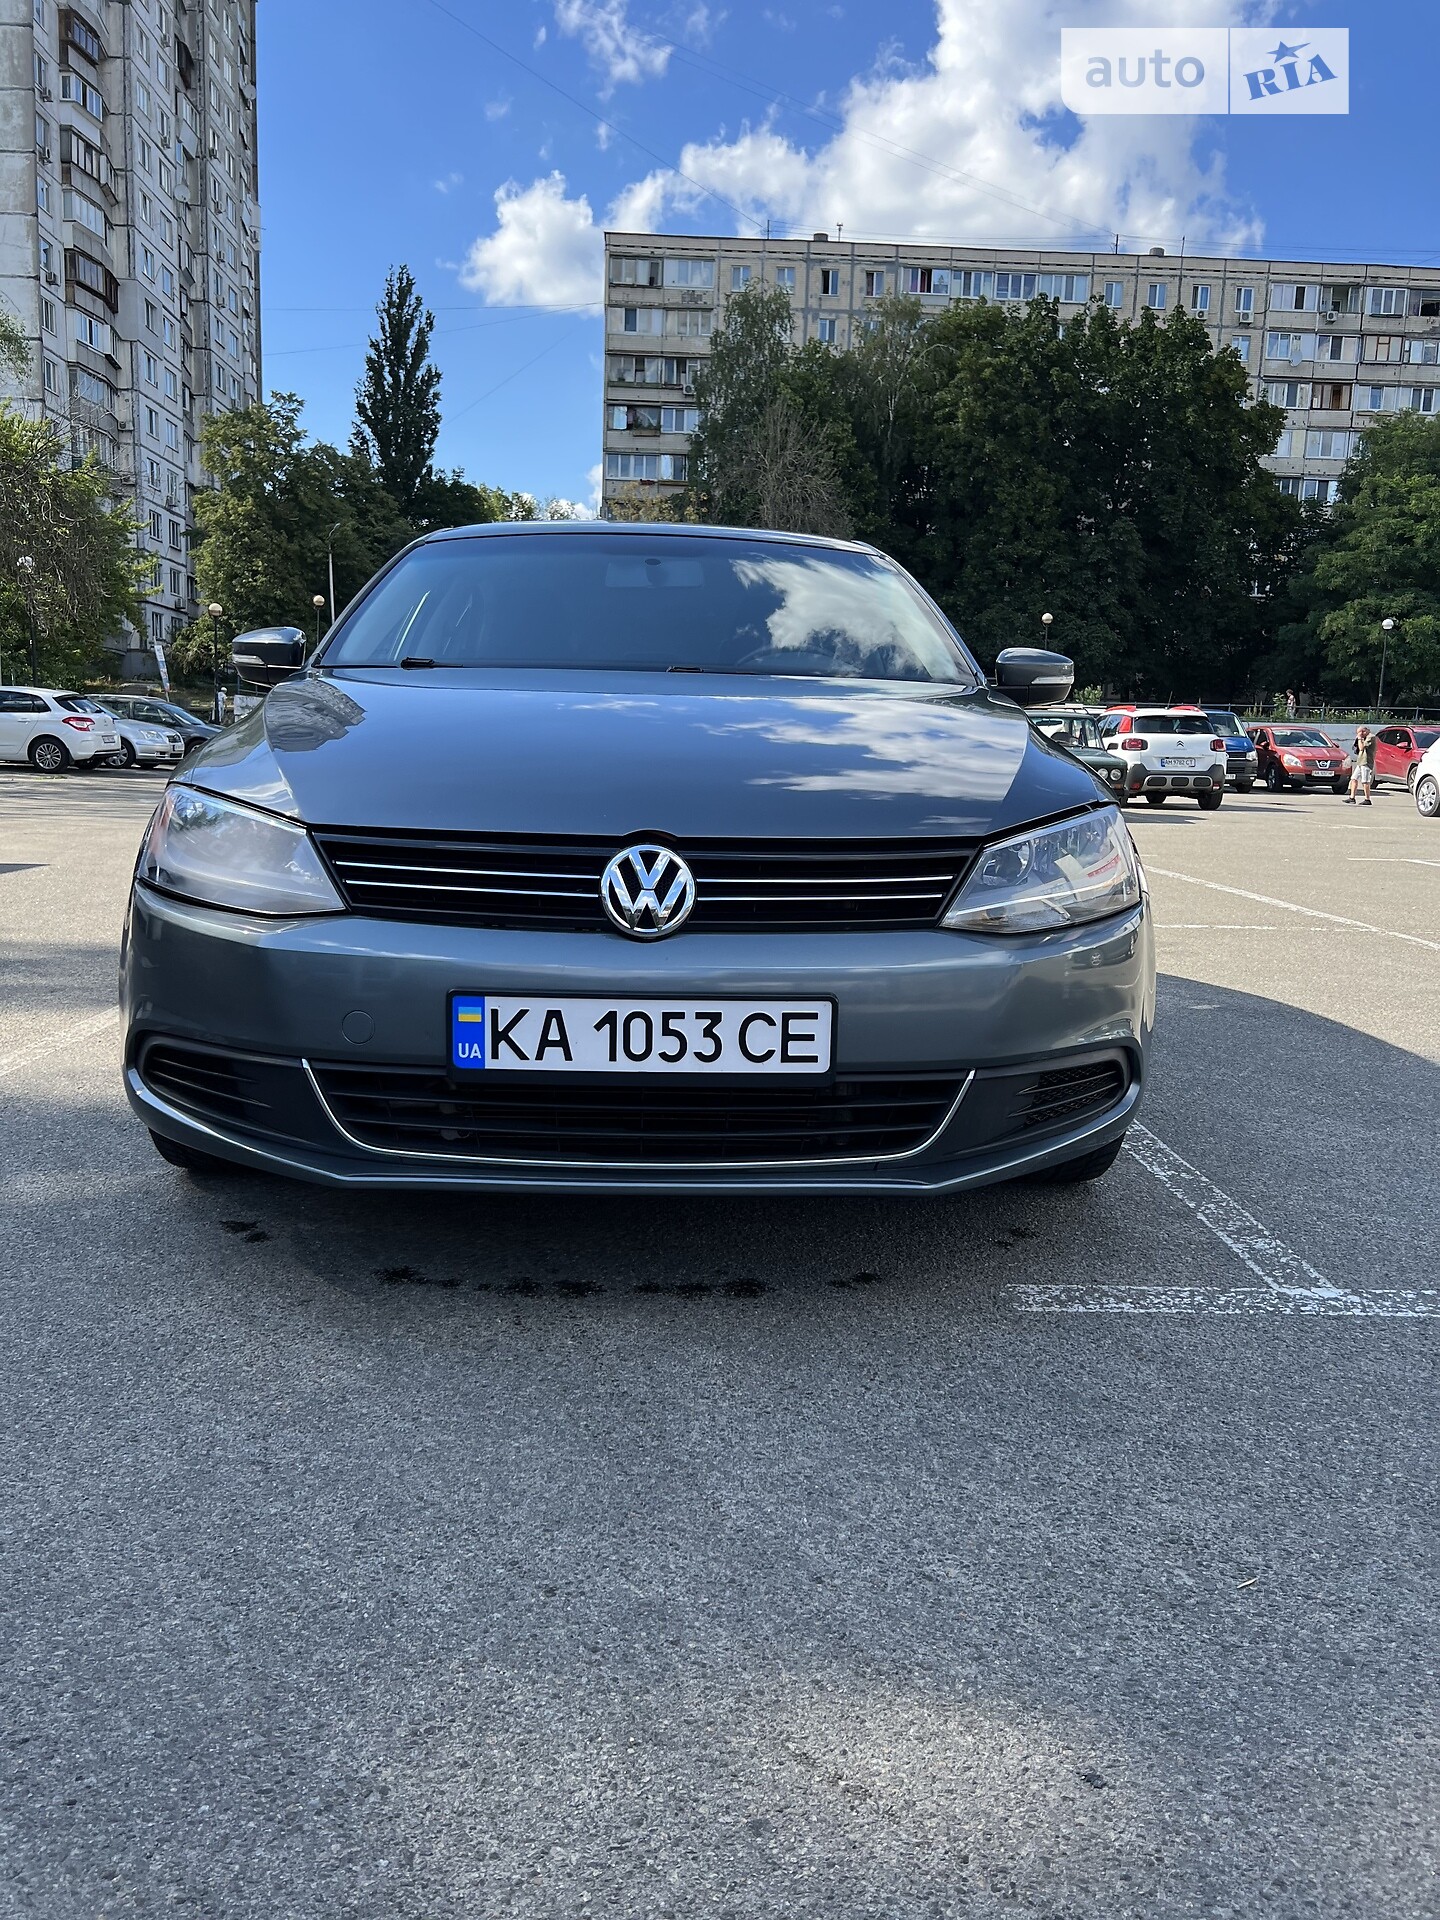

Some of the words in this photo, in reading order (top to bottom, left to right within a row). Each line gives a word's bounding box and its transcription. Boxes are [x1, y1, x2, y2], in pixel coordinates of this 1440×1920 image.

[601, 844, 696, 938] VW
[458, 1042, 482, 1059] UA
[490, 1008, 573, 1061] KA
[593, 1010, 723, 1063] 1053
[738, 1011, 820, 1064] CE
